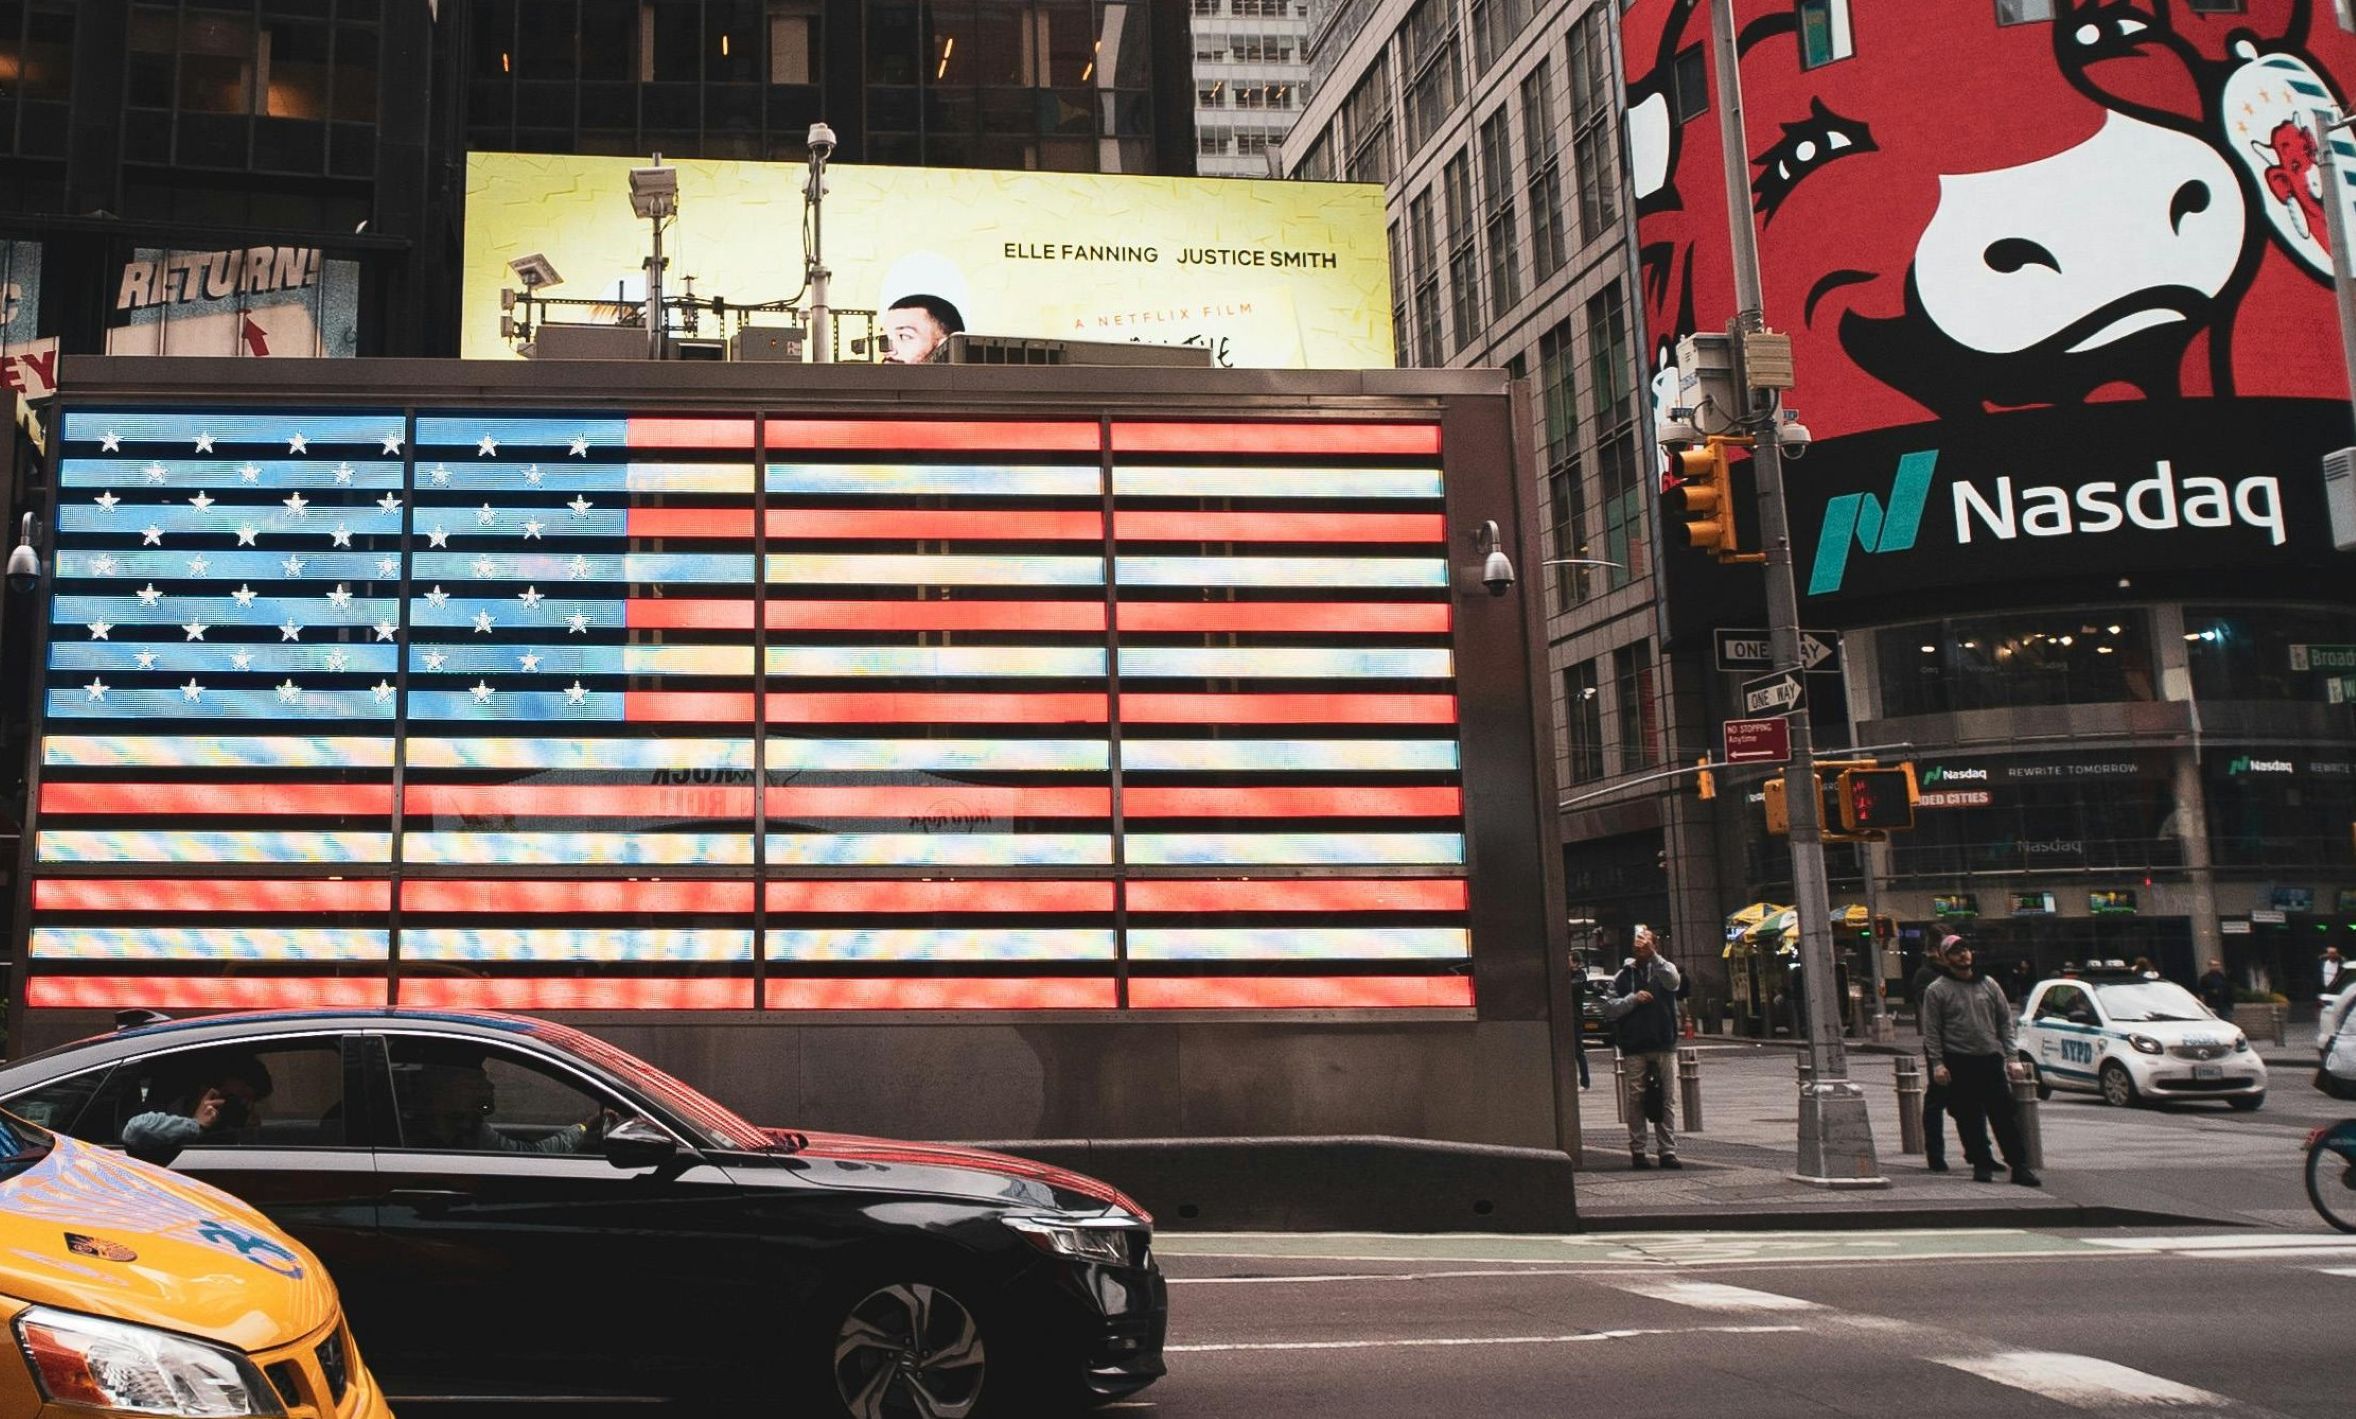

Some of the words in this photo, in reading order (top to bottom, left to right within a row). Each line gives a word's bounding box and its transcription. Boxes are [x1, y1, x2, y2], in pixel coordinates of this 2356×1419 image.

[1004, 243, 1055, 259] ELLE
[1062, 244, 1159, 263] FANNING
[1177, 248, 1265, 267] JUSTICE
[1270, 251, 1337, 268] SMITH
[116, 246, 320, 310] RETURN!
[1075, 318, 1085, 329] A
[1098, 308, 1190, 327] NETFLIX
[1203, 303, 1252, 318] FILM
[1952, 460, 2287, 546] Nasdaq
[1734, 642, 1770, 658] ONE
[1800, 643, 1820, 659] AY
[1751, 689, 1769, 709] ONE
[1776, 683, 1796, 702] WAY
[1727, 725, 1737, 733] NO
[1740, 723, 1773, 733] STOPPING
[1728, 735, 1758, 745] Anytime
[1943, 767, 1987, 780] Nasdaq
[2008, 766, 2062, 777] REWRITE
[2068, 764, 2138, 775] TOMORROW
[1919, 794, 1945, 806] DED
[1947, 791, 1989, 805] CITIES
[2016, 838, 2082, 855] Nasdaq
[2061, 1038, 2092, 1064] NYPD
